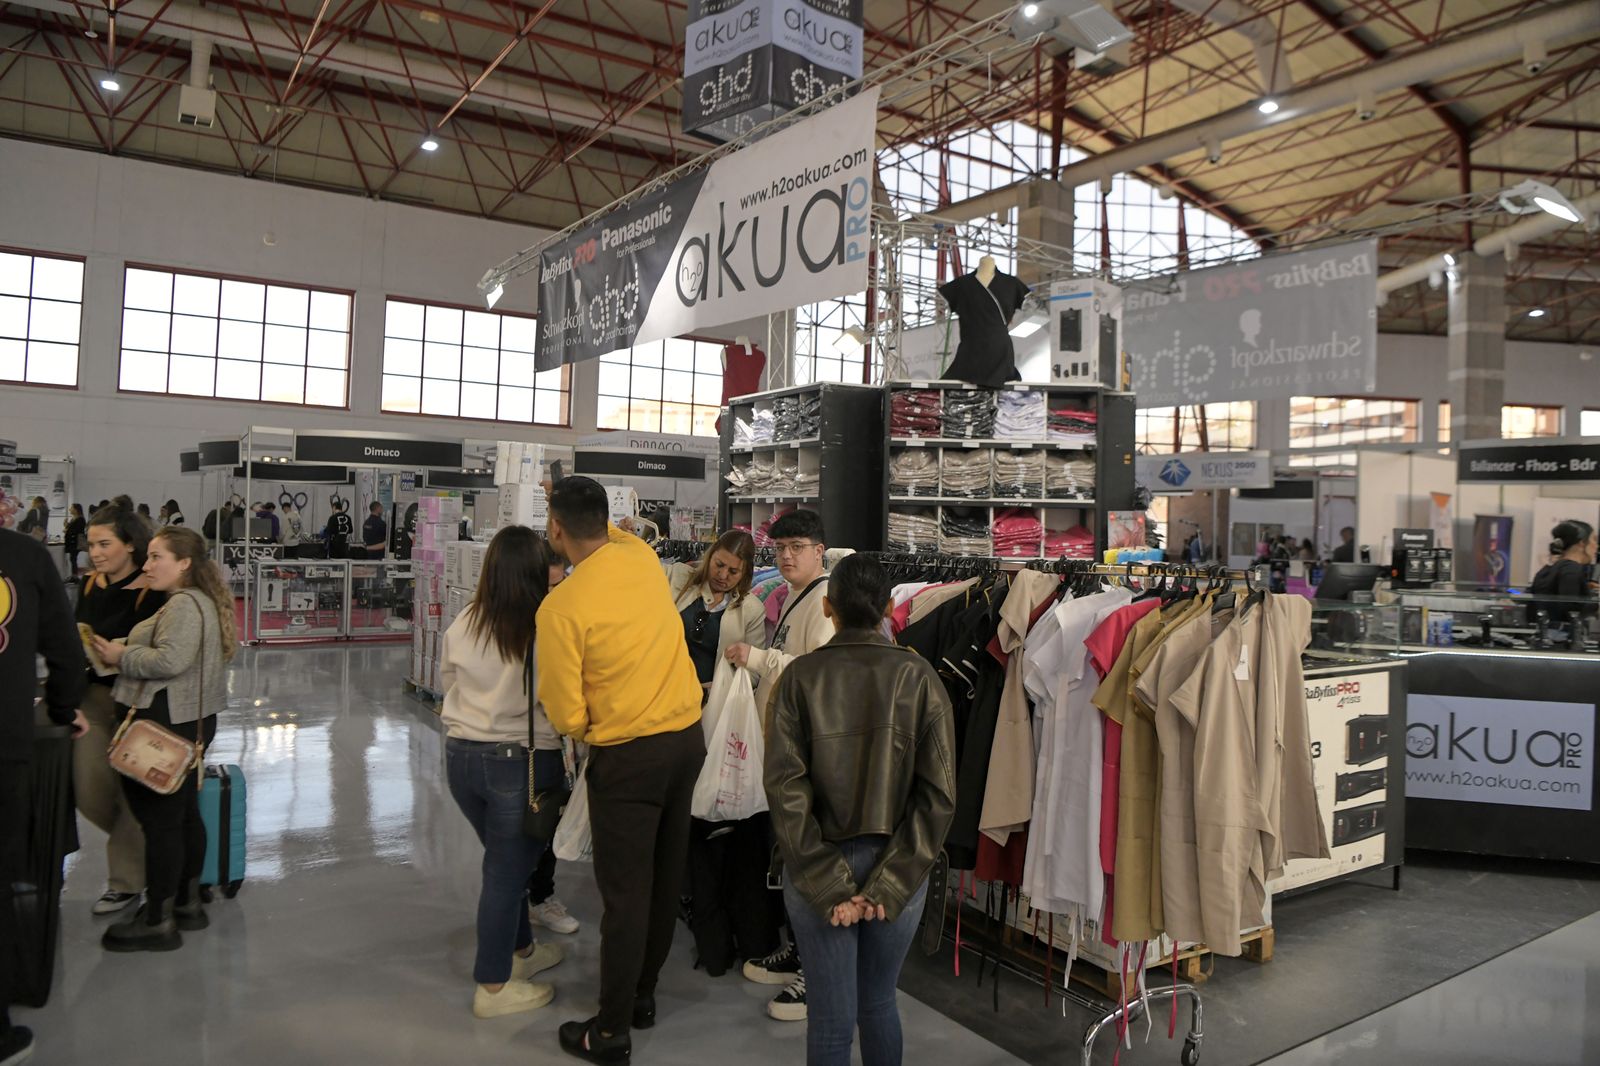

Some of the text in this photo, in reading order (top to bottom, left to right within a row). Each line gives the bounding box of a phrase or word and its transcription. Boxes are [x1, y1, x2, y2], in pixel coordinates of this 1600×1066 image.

[695, 10, 752, 51] akua
[784, 8, 846, 51] akua
[700, 54, 752, 116] ghd
[740, 148, 867, 211] www.h2oakua.com
[602, 202, 672, 252] Panasonic
[675, 176, 868, 308] akua PRO
[542, 306, 585, 340] Schwazkopf
[589, 262, 639, 347] ghd
[364, 446, 400, 457] Dimaco
[638, 461, 666, 471] Dimaco
[1202, 462, 1233, 478] NEXUS
[1235, 461, 1256, 469] 2000
[1525, 459, 1558, 471] Fhos
[1569, 458, 1597, 471] Bdr
[1405, 712, 1583, 768] akua PRO
[1405, 770, 1581, 794] www.h2oakua.com
